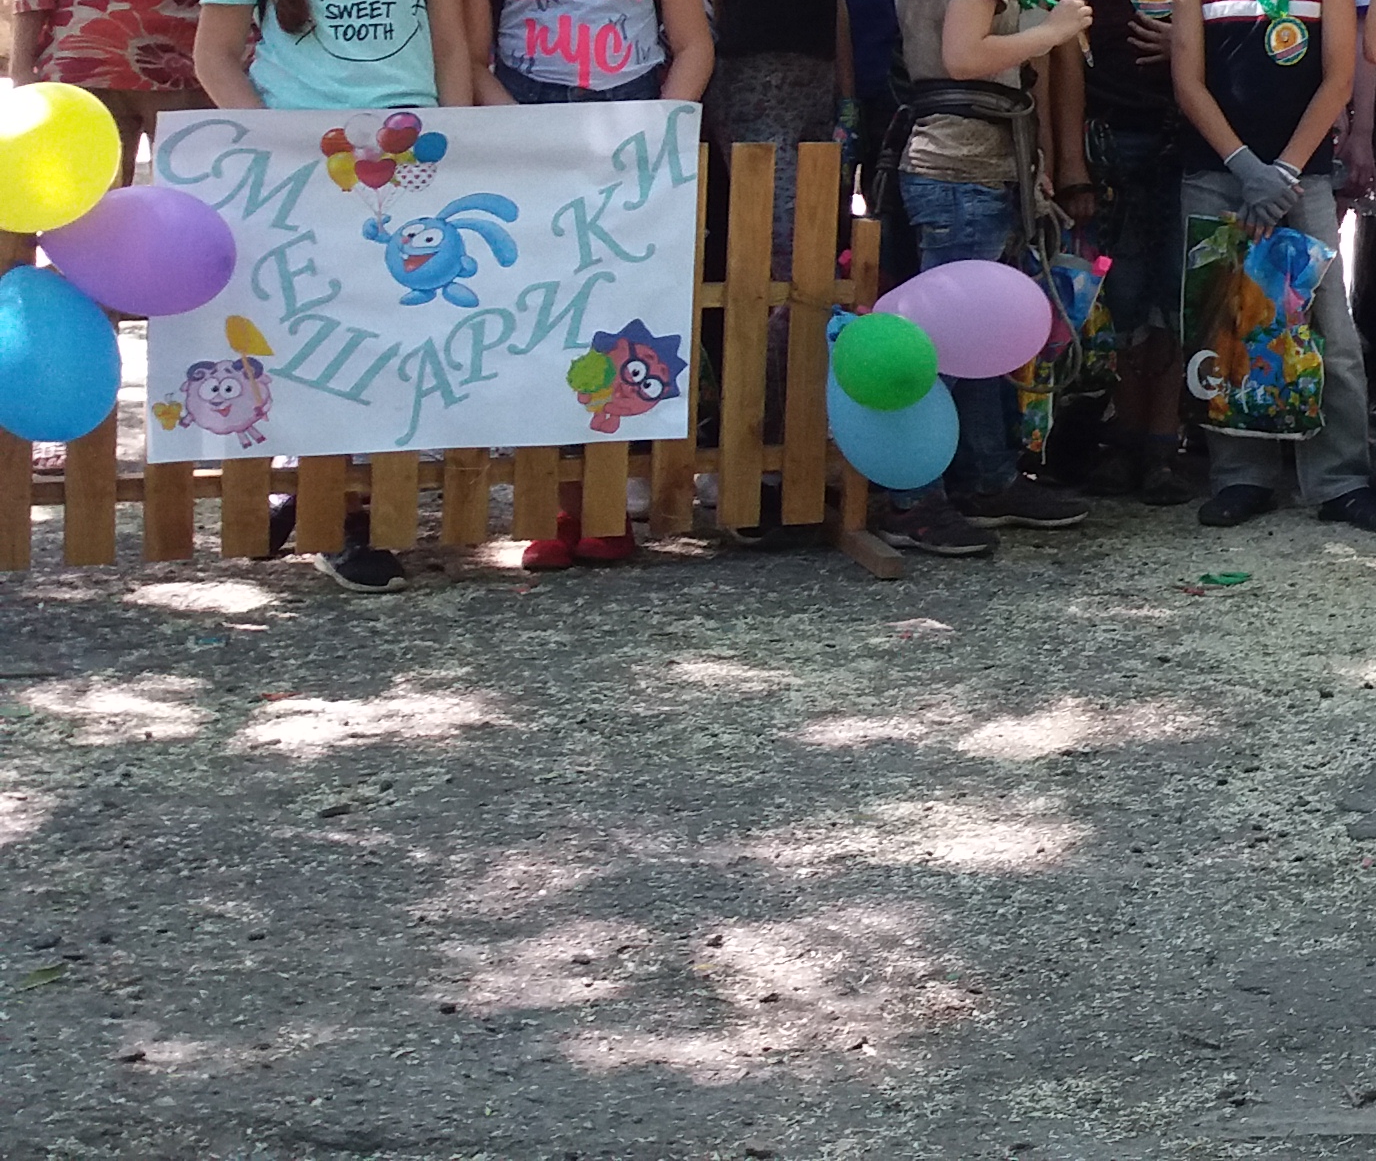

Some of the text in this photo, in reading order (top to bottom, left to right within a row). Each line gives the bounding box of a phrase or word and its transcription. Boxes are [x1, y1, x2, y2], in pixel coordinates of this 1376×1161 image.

[325, 0, 397, 19] SWEET
[328, 22, 395, 41] TOOTH
[158, 105, 698, 446] СМЕШАРИКИ
